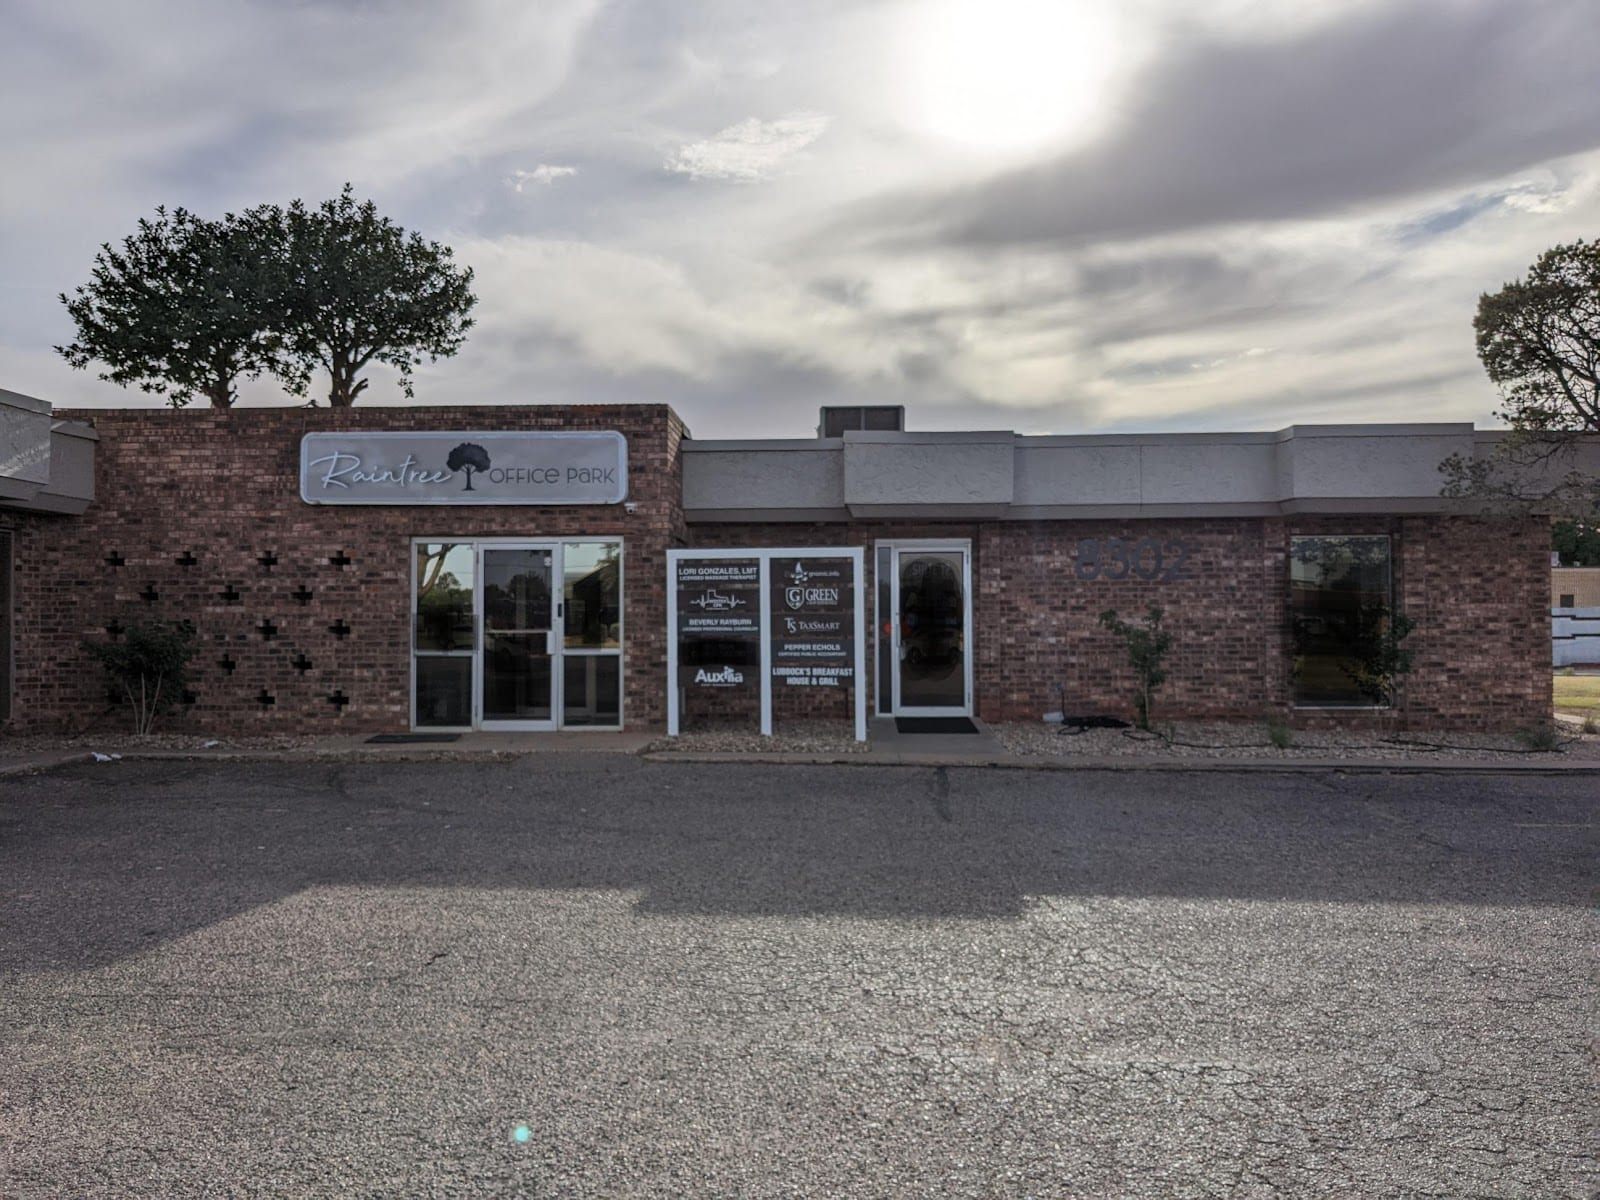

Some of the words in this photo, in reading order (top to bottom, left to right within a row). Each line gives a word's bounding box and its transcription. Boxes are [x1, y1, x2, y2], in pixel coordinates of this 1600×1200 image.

[310, 451, 451, 489] Raintree
[1076, 538, 1192, 582] 8302
[678, 567, 697, 576] LORI
[698, 567, 741, 576] GONZALES,
[742, 567, 758, 575] LMT
[789, 589, 800, 602] G
[805, 588, 838, 601] GREEN
[689, 618, 719, 626] BEVERLY
[719, 618, 752, 626] RAYBURN
[783, 643, 811, 651] PEPPER
[812, 643, 841, 651] ECHOLS
[772, 667, 811, 676] LUBBOCK'S
[812, 667, 853, 677] BREAKFAST
[786, 677, 810, 686] HOUSE
[811, 677, 817, 686] &
[819, 677, 839, 686] GRILL
